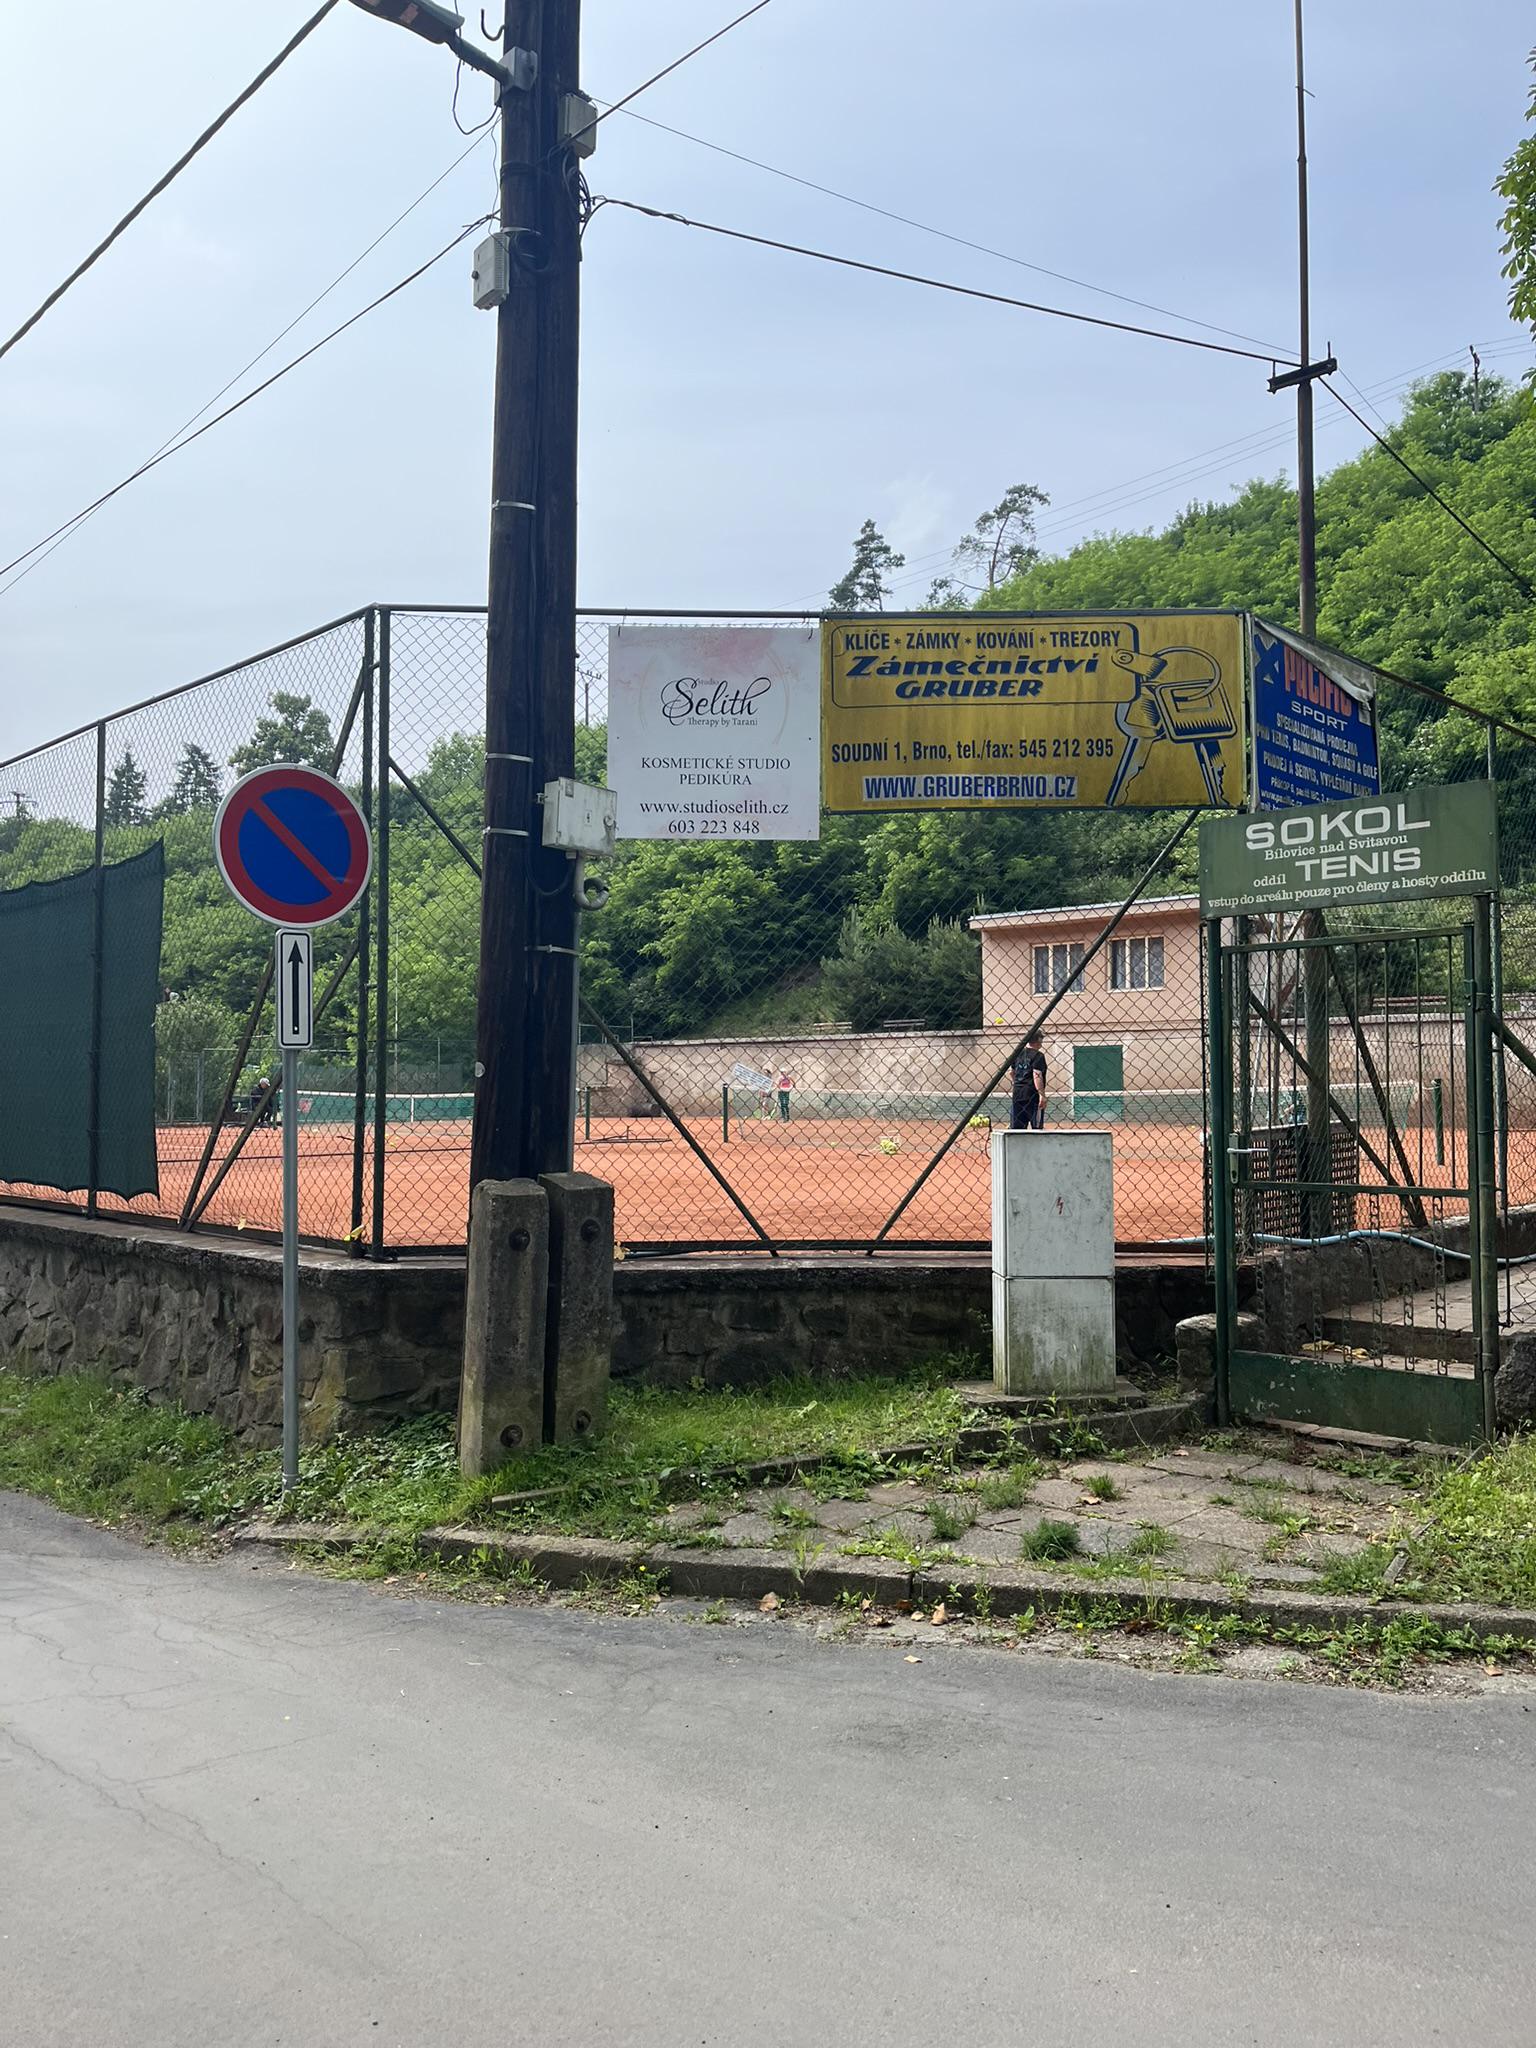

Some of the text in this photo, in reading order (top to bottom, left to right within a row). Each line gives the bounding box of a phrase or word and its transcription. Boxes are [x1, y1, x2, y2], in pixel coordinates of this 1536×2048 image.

[844, 628, 1121, 651] KLÍČE ZÁMKY KOVÁNÍ TREZORY
[846, 652, 1100, 676] Zámečnictví
[661, 677, 771, 723] Selith
[895, 679, 1044, 699] GRUBER
[687, 716, 719, 728] Therapy
[721, 717, 731, 728] by
[1291, 700, 1349, 732] SPORT
[641, 755, 791, 770] KOSMETICKÉ STUDIO
[831, 738, 1114, 764] SOUDNÍ 1, Brno, tel./fax: 545 212 395
[679, 771, 752, 786] PEDIKÚRA
[1362, 763, 1378, 780] GOLF
[864, 775, 1077, 799] WWW.GRUBERBRNO.CZ
[639, 800, 790, 814] www.studioselith.cz
[668, 820, 760, 834] 603 223 848
[1245, 803, 1431, 850] SOKOL
[1265, 834, 1409, 860] Bílovice nad Svitavou
[1253, 847, 1421, 888] oddíl TENIS
[1207, 869, 1487, 909] vstup do areálu pouze pro členy a hosty oddílu
